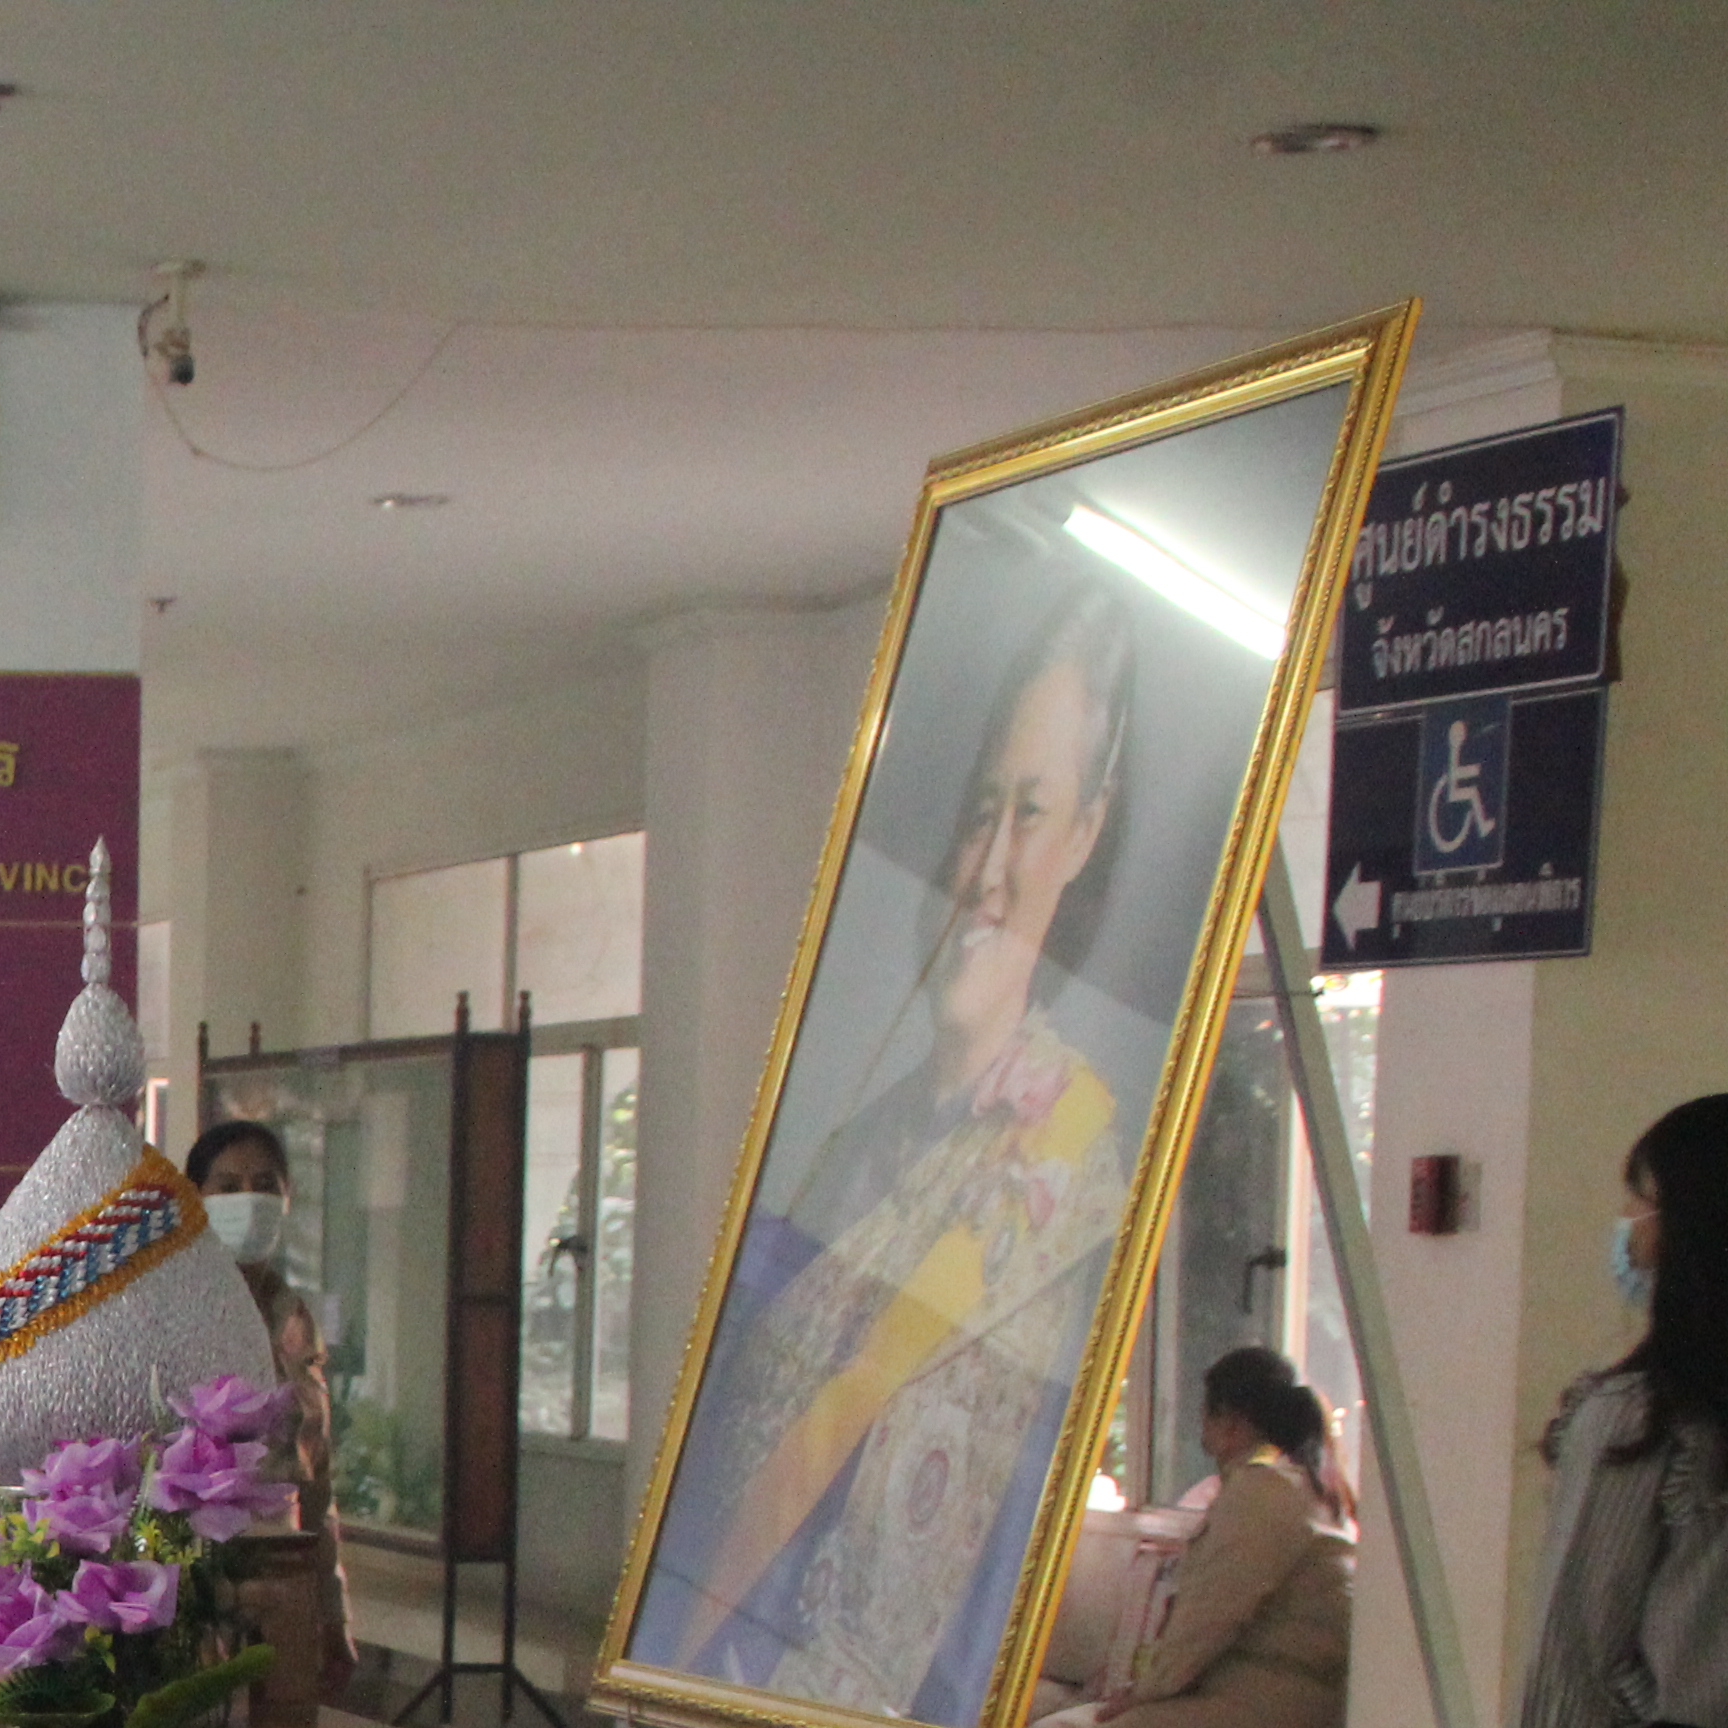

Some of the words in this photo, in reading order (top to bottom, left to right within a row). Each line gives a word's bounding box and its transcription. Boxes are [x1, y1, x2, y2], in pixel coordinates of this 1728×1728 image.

[1351, 476, 1606, 611] ศูนย์ดำรงธรรม
[1371, 606, 1570, 679] จังหวัดสกลนคร
